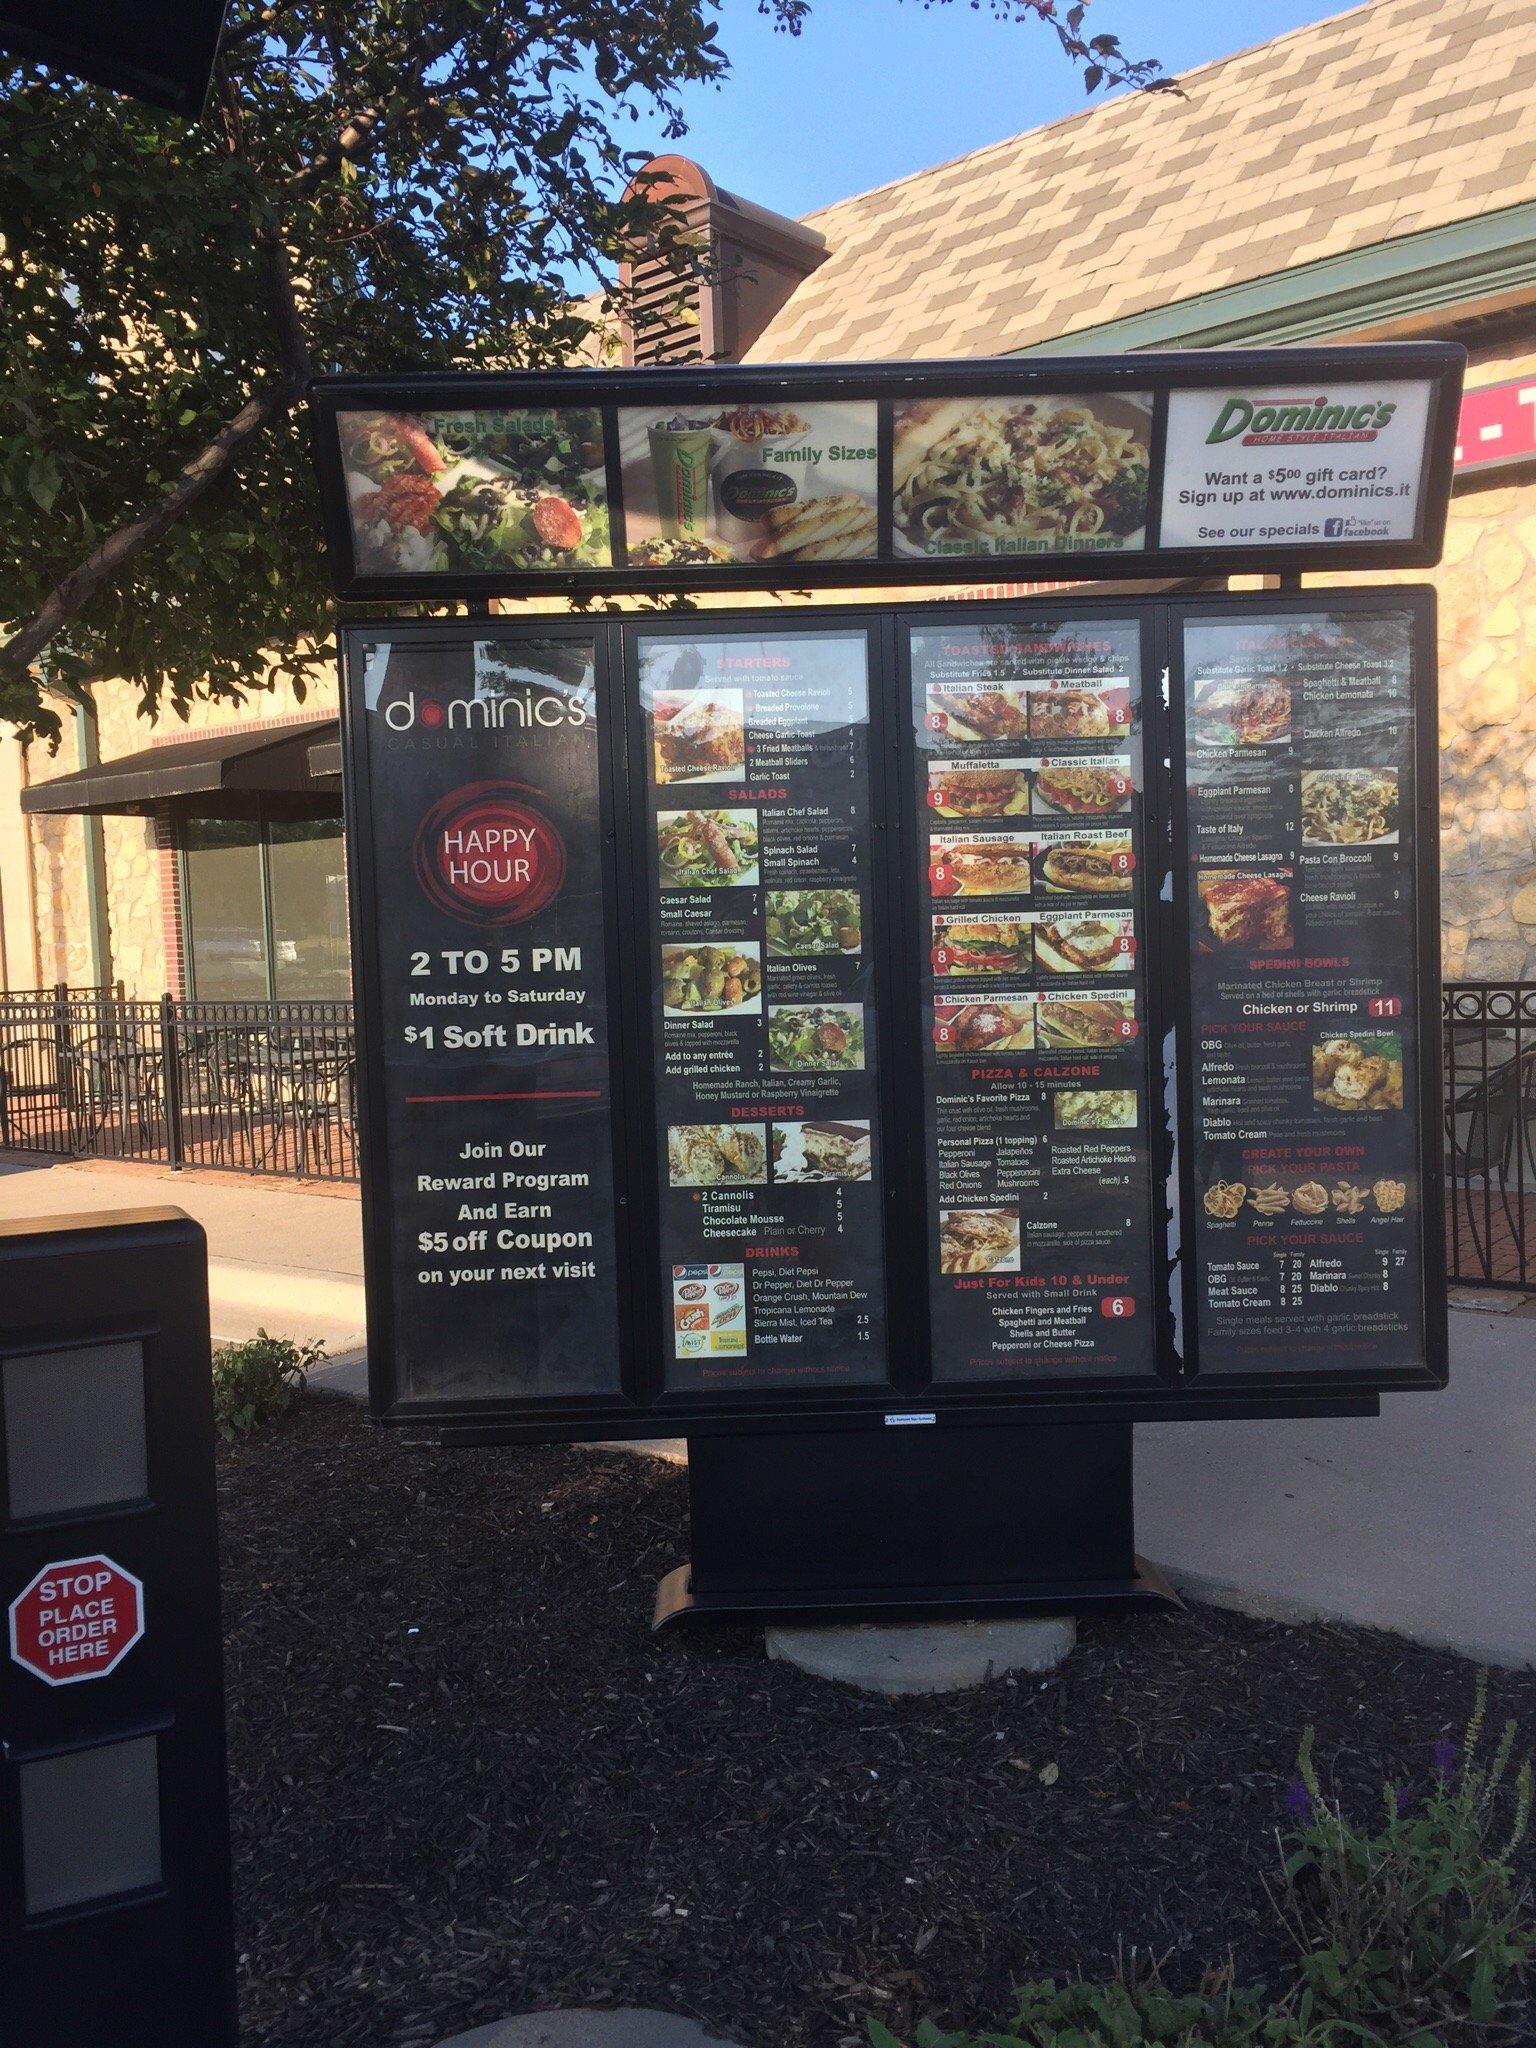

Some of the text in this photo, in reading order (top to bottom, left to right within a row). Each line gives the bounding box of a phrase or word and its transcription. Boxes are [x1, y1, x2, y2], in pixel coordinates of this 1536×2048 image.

[435, 416, 555, 435] Fresh Salads
[1205, 396, 1397, 444] Dominic's
[1253, 431, 1369, 443] HOME STYLE ITALIAN
[762, 445, 877, 466] Family Sizes
[1205, 472, 1248, 485] Want
[1253, 474, 1262, 484] a
[1306, 468, 1334, 485] gift
[1339, 466, 1387, 481] card?
[1179, 484, 1410, 507] Sign up at www.dominics.it
[1198, 523, 1319, 538] See our specials
[1344, 527, 1389, 537] facebook
[924, 535, 1124, 555] Classic Italian Dinners
[943, 683, 1004, 691] Italian Steak
[1061, 680, 1102, 688] Meatball
[384, 734, 586, 751] CASUAL ITALIAN
[951, 761, 999, 769] Muffaletta
[1051, 758, 1087, 766] Classic
[750, 770, 855, 781] Garlic Toast 2
[728, 789, 787, 799] SALADS
[762, 806, 855, 816] Italian Chef Salad 8
[1197, 822, 1294, 835] Taste of Italy 12
[444, 828, 536, 854] HAPPY
[940, 835, 1014, 844] Italian Sausage
[1041, 830, 1128, 840] Italian Roast Beef
[763, 844, 856, 856] Spinach Salad 7
[1300, 853, 1398, 864] Pasta Con Broccoli 9
[450, 859, 531, 884] HOUR
[660, 894, 757, 904] Caesar Salad 7
[946, 914, 1020, 923] Grilled Chicken
[1040, 911, 1132, 922] Eggplant Parmesan
[410, 947, 582, 976] 2 TO 5 PM
[767, 964, 790, 973] Italian
[792, 963, 817, 972] Olives
[410, 988, 585, 1008] Monday to Saturday
[945, 994, 1028, 1004] Chicken Parmesan
[1048, 991, 1127, 1000] Chicken Spedini
[1243, 1000, 1394, 1015] Chicken or Shrimp 11
[664, 1019, 762, 1029] Dinner Salad 3
[404, 1022, 595, 1049] $1 Soft Drink
[1201, 1040, 1222, 1049] OBG
[665, 1063, 763, 1075] Add grilled chicken 2
[971, 1066, 1100, 1079] PIZZA & CALZONE
[1202, 1063, 1234, 1072] Alfredo
[1202, 1076, 1246, 1085] Lemonata
[1203, 1097, 1241, 1106] Marinara
[731, 1106, 805, 1117] DESSERTS
[1203, 1118, 1231, 1127] Diablo
[1203, 1130, 1267, 1140] Tomato Cream
[460, 1140, 545, 1159] Join Our
[417, 1170, 588, 1193] Reward Program
[702, 1188, 841, 1201] 2 Cannolis 4
[458, 1202, 551, 1220] And Earn
[702, 1200, 842, 1213] Tiramisu 5
[703, 1213, 843, 1225] Chocolate Mousse 5
[703, 1225, 843, 1238] Cheesecake 4
[497, 1230, 593, 1253] Coupon
[746, 1247, 800, 1258] DRINKS
[418, 1261, 595, 1286] on your next visit
[954, 1274, 1130, 1289] Just For Kids 10 & Under
[1208, 1285, 1302, 1296] Meat Sauce 8 25
[1112, 1299, 1124, 1315] 6
[755, 1331, 869, 1344] Bottle Water 1.5
[39, 1571, 112, 1602] STOP
[39, 1598, 115, 1627] PLACE
[38, 1619, 117, 1647] ORDER
[48, 1639, 109, 1665] HERE
